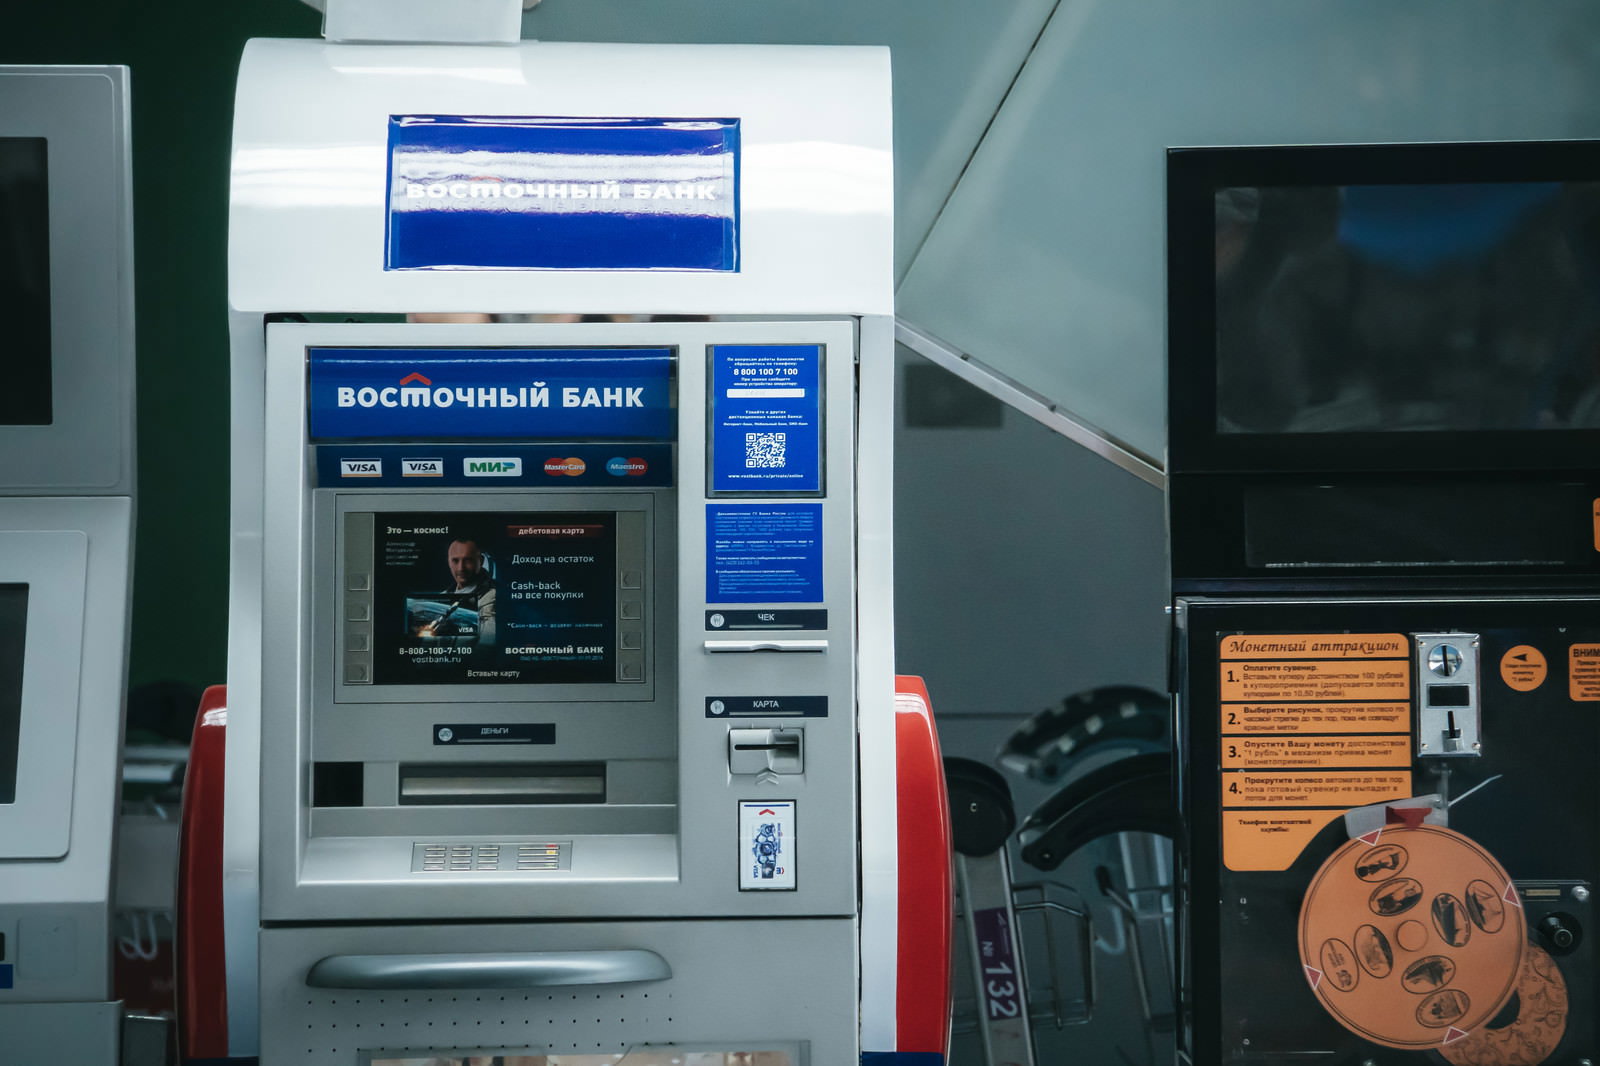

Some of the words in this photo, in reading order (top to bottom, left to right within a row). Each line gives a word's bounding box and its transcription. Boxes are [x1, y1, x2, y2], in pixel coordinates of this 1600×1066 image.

[406, 180, 620, 200] ВОСТОЧНЫЙ
[633, 184, 716, 200] БАНК
[337, 381, 549, 408] ВОСТОЧНЫЙ
[562, 387, 644, 408] БАНК
[347, 463, 377, 472] VISA
[409, 463, 437, 471] VISA
[469, 462, 516, 473] МИР
[386, 526, 402, 534] Это
[413, 526, 449, 534] космос!
[511, 554, 542, 565] Доход
[511, 581, 561, 590] Cash-back
[544, 592, 584, 600] покупки
[758, 613, 775, 621] ЧЕК
[399, 647, 472, 655] 8-800-100-7-100
[577, 646, 604, 654] БАНК
[1230, 640, 1307, 652] Монетный
[1311, 641, 1399, 656] аттракцион
[412, 655, 462, 663] vostbank.ru
[1227, 670, 1240, 682] 1.
[753, 700, 779, 708] КАРТА
[1228, 712, 1241, 725] 2.
[481, 727, 509, 735] ДЕНЬГИ
[1228, 745, 1241, 758] 3.
[1229, 782, 1242, 794] 4.
[985, 962, 1018, 1017] 132
